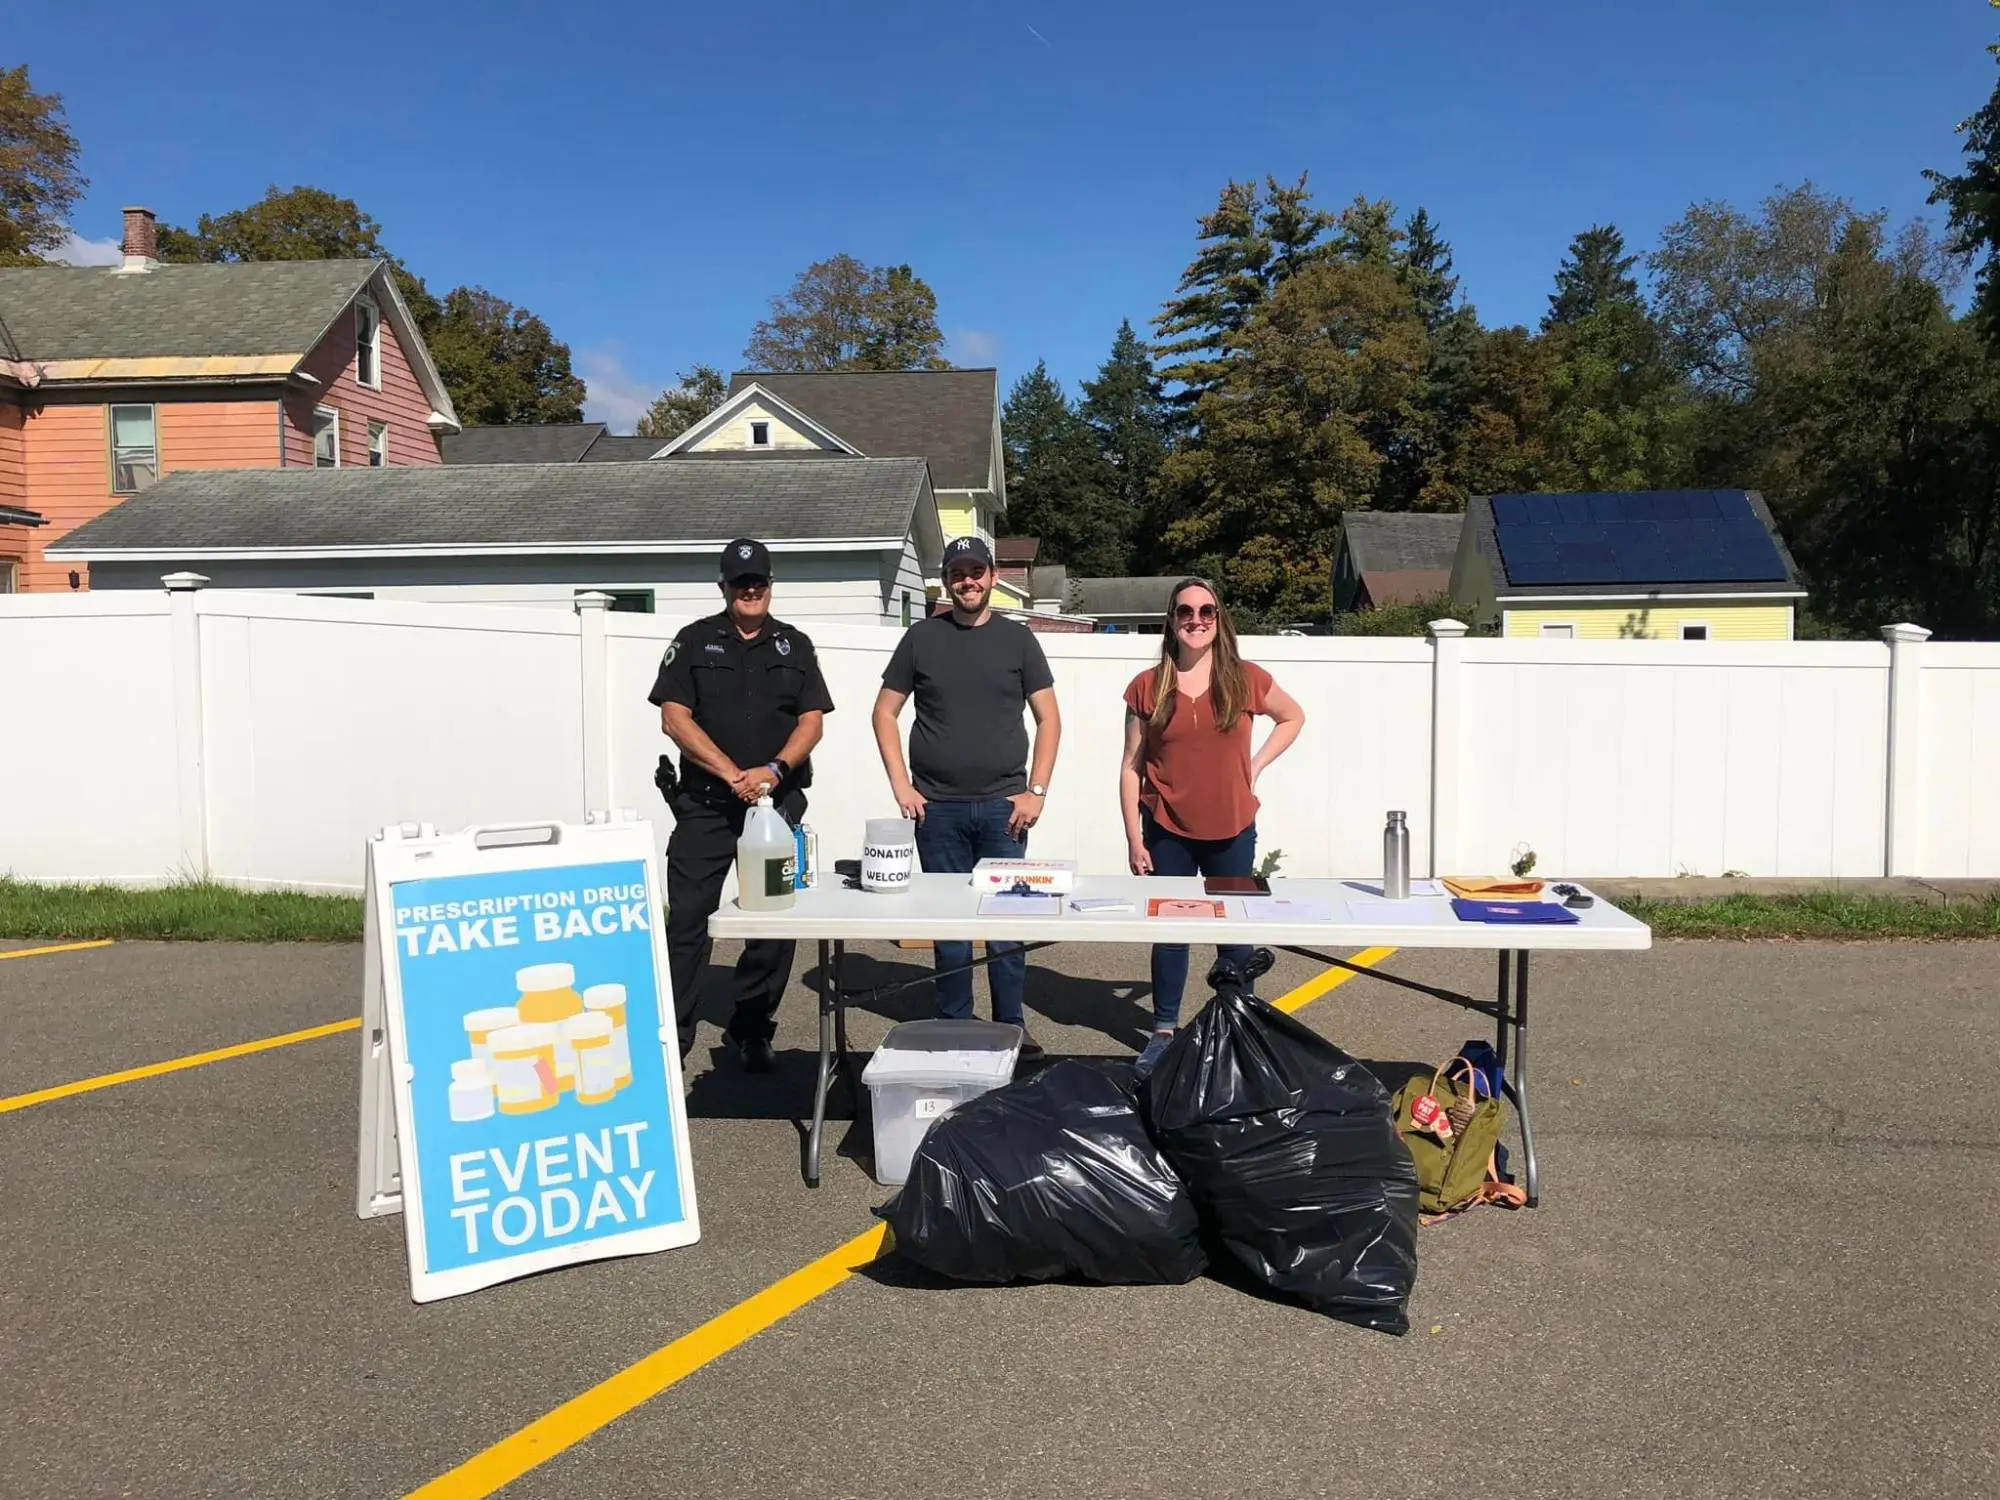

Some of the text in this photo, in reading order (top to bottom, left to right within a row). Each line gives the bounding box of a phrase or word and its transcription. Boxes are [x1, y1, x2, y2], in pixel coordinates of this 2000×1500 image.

[396, 883, 646, 925] PRESCRIPTION DRUG
[396, 902, 652, 957] TAKE BACK
[924, 1101, 936, 1112] 13
[450, 1121, 649, 1203] EVENT
[450, 1170, 656, 1254] TODAY
